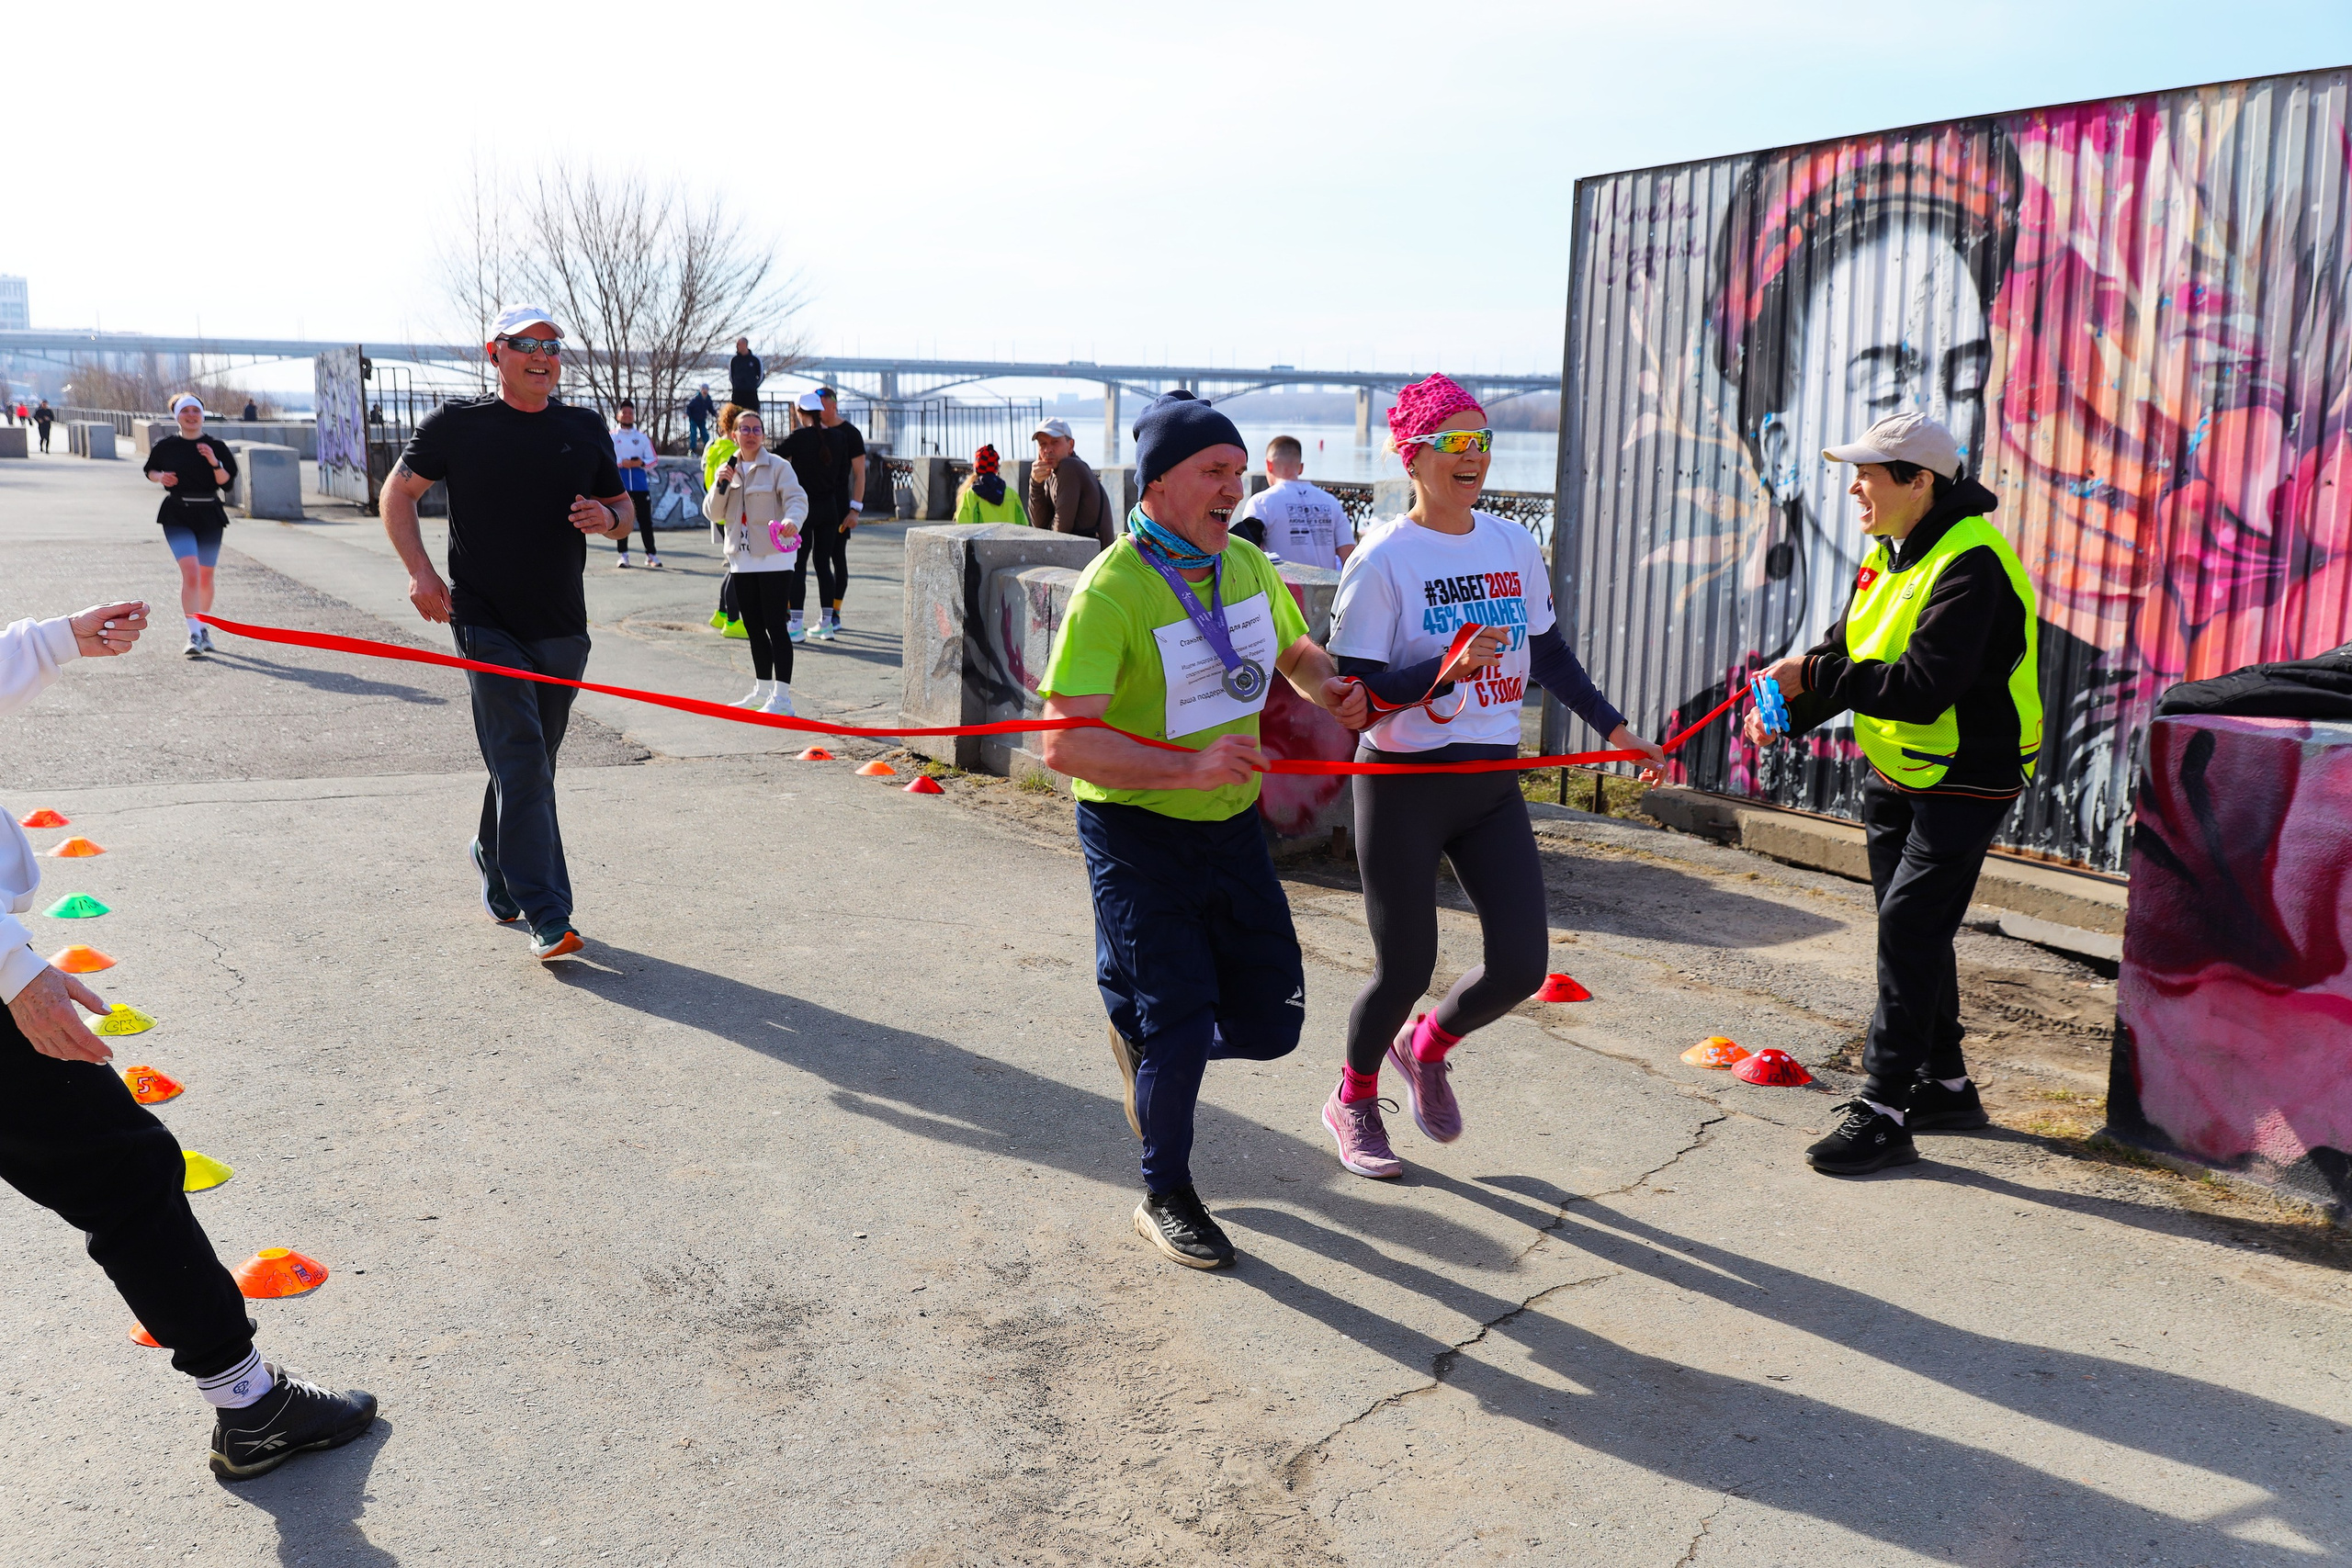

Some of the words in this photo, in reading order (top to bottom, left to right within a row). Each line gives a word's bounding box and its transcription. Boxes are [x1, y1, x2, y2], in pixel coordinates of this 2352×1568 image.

[1424, 571, 1521, 606] #ЗАБЕГ2025
[1180, 635, 1204, 648] Станьте
[1228, 623, 1241, 634] для
[1241, 615, 1261, 630] другого!
[1423, 604, 1463, 636] 45%
[1180, 696, 1196, 706] Ваша
[1197, 688, 1226, 701] поддерж
[1475, 682, 1489, 707] С
